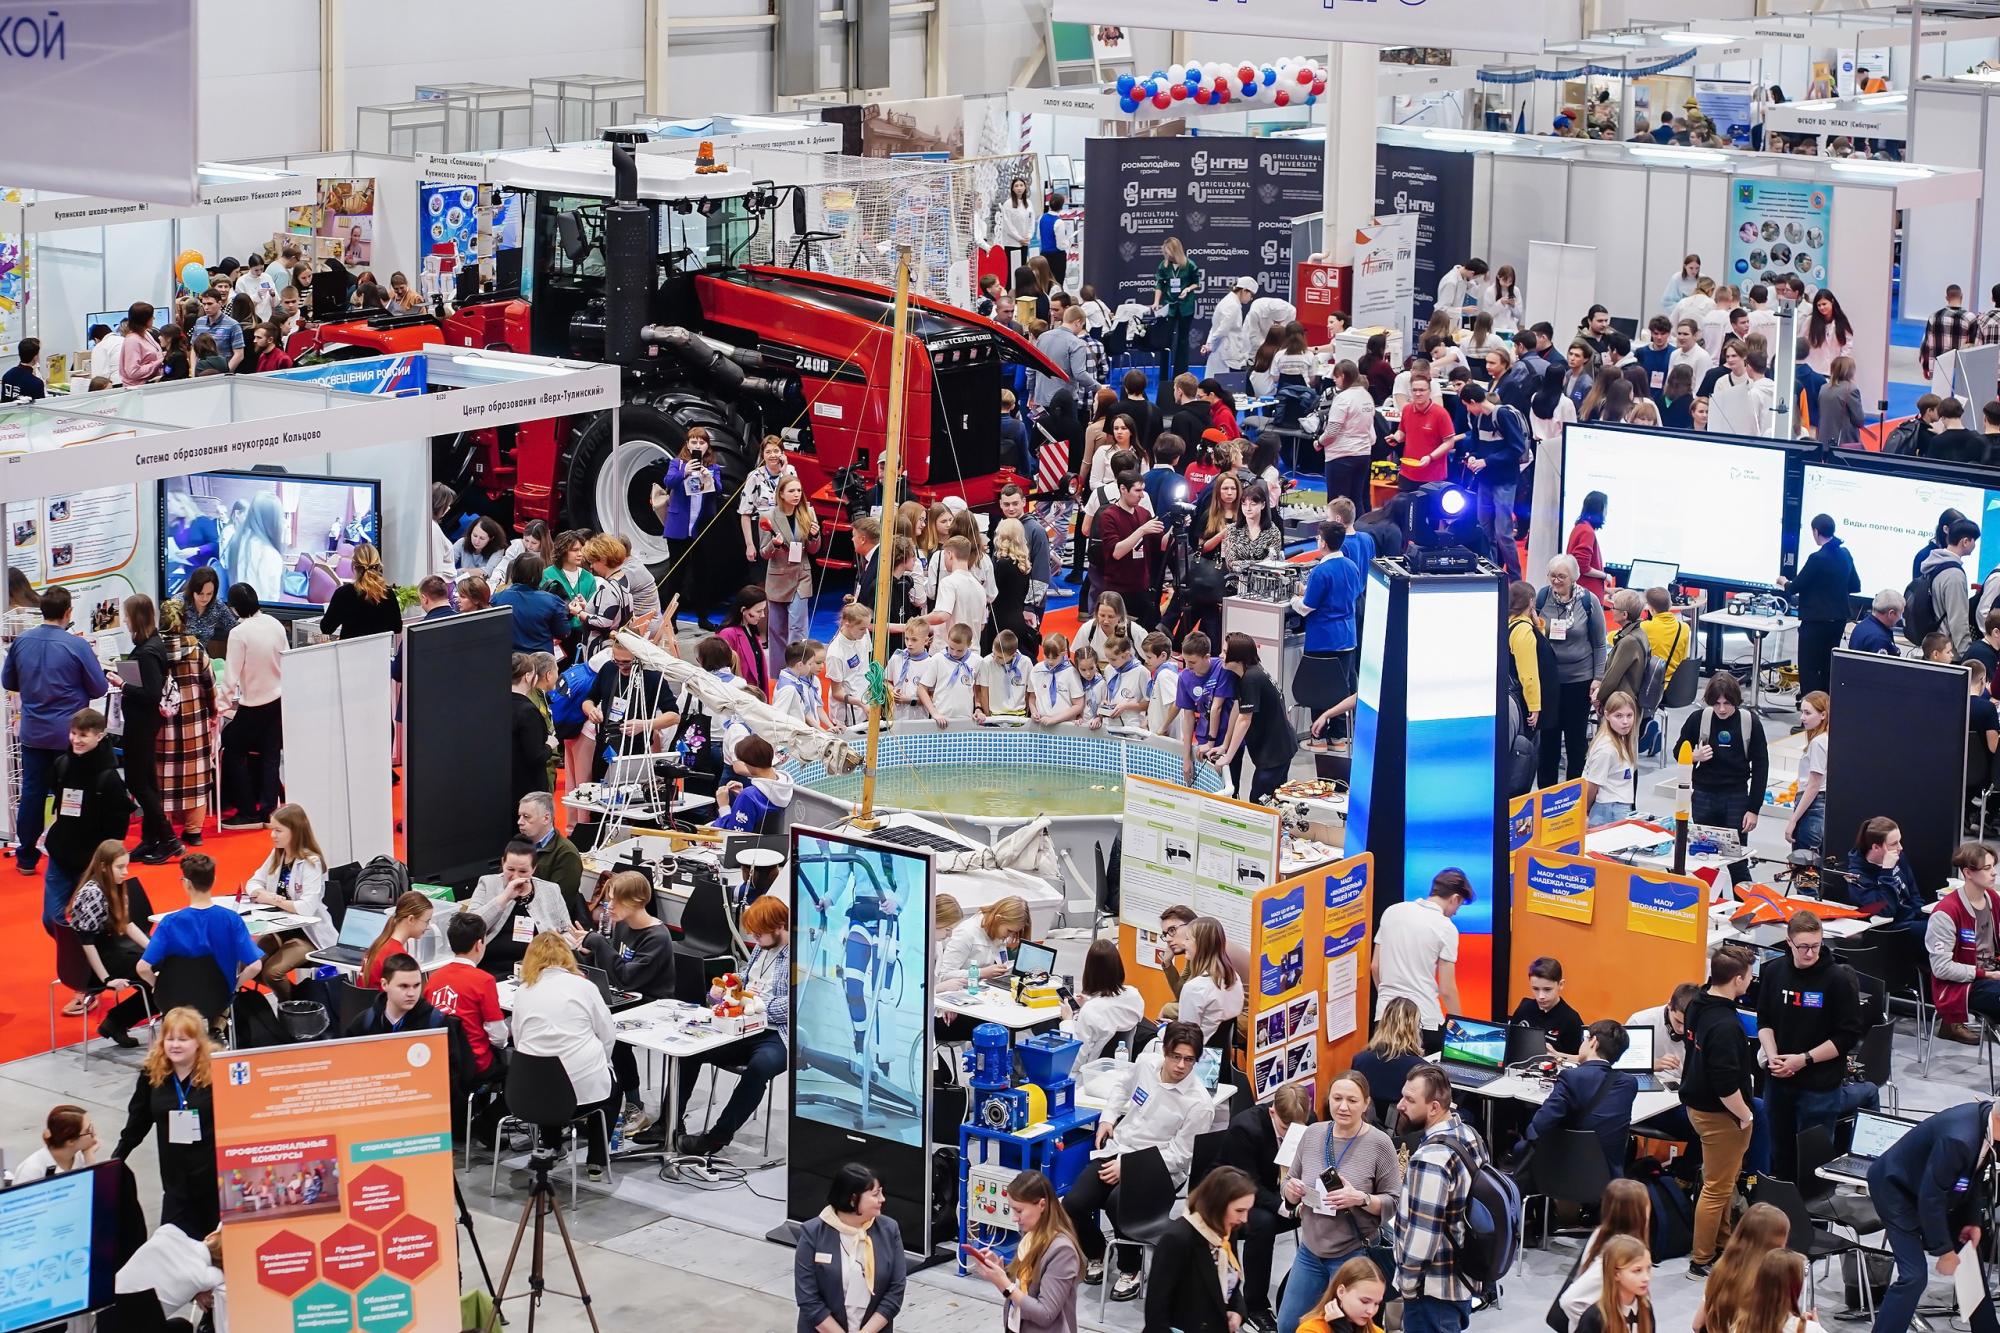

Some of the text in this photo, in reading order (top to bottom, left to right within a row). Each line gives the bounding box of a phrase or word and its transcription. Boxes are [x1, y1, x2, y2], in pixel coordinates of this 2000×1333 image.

[1797, 117, 1816, 126] ФГБОУ
[1210, 158, 1248, 169] НГАУ
[1141, 188, 1176, 199] НГАУ
[55, 209, 86, 220] Купинская
[795, 355, 829, 373] 2400
[376, 366, 411, 379] РОССИИ
[463, 385, 605, 416] Центр образования «Верх-Тулинский»
[136, 429, 321, 466] Система образования наукограда Кольцово
[1843, 518, 1867, 528] Виды
[1869, 523, 1903, 534] полетов
[1537, 870, 1555, 878] МАОУ
[1530, 876, 1564, 887] «НАДЕЖДА
[1552, 888, 1570, 896] МАОУ
[1653, 897, 1674, 907] МАОУ
[1632, 902, 1696, 919] ВТОРАЯ ГИМНАЗИЯ
[225, 1139, 329, 1157] ПРОФЕССИОНАЛЬНЫЕ
[251, 1150, 303, 1164] КОНКУРСЫ
